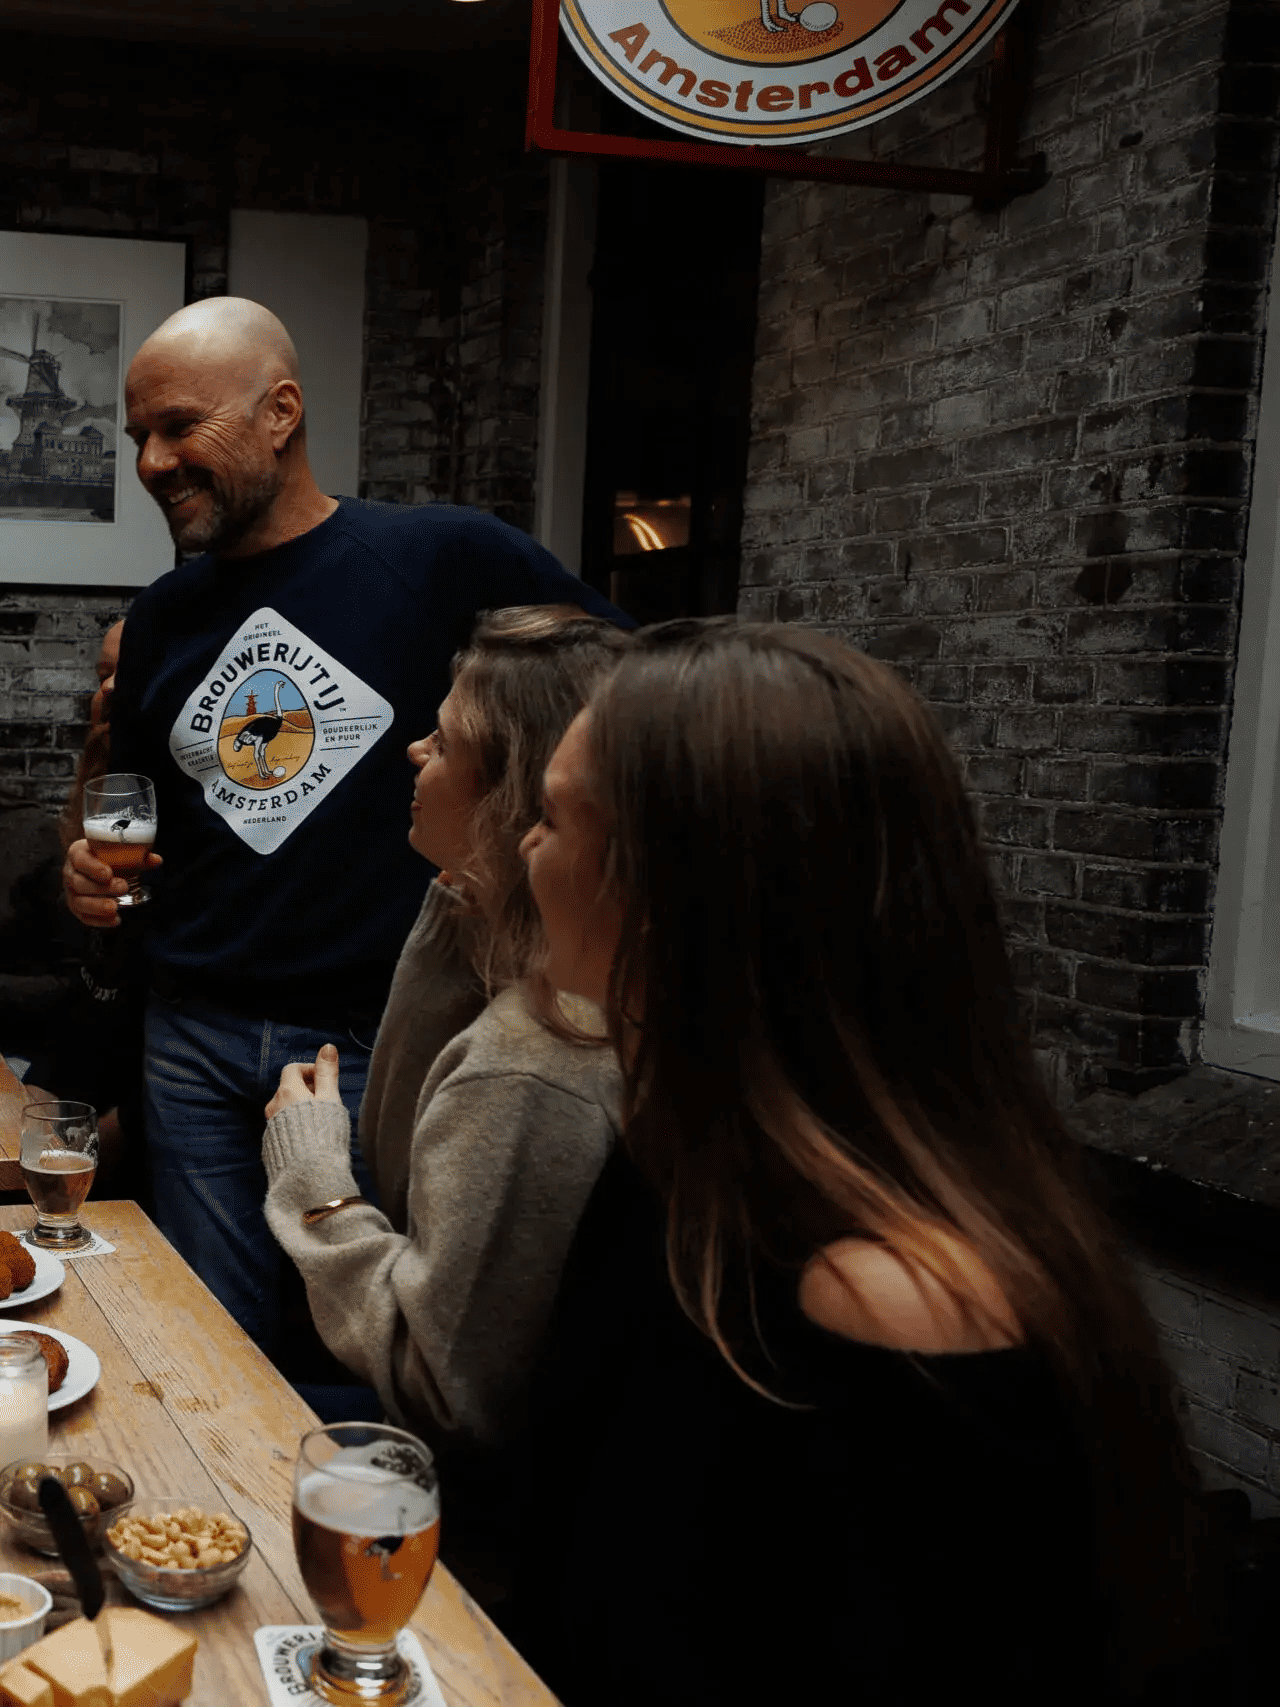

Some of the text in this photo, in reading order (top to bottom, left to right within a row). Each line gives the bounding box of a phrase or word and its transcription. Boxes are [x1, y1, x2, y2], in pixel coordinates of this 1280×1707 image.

[607, 0, 972, 113] Amsterdam
[255, 622, 269, 630] HET
[322, 723, 378, 734] GOUDEERLIJK
[325, 733, 361, 743] EN PUUR
[243, 815, 287, 824] NEDERLAND
